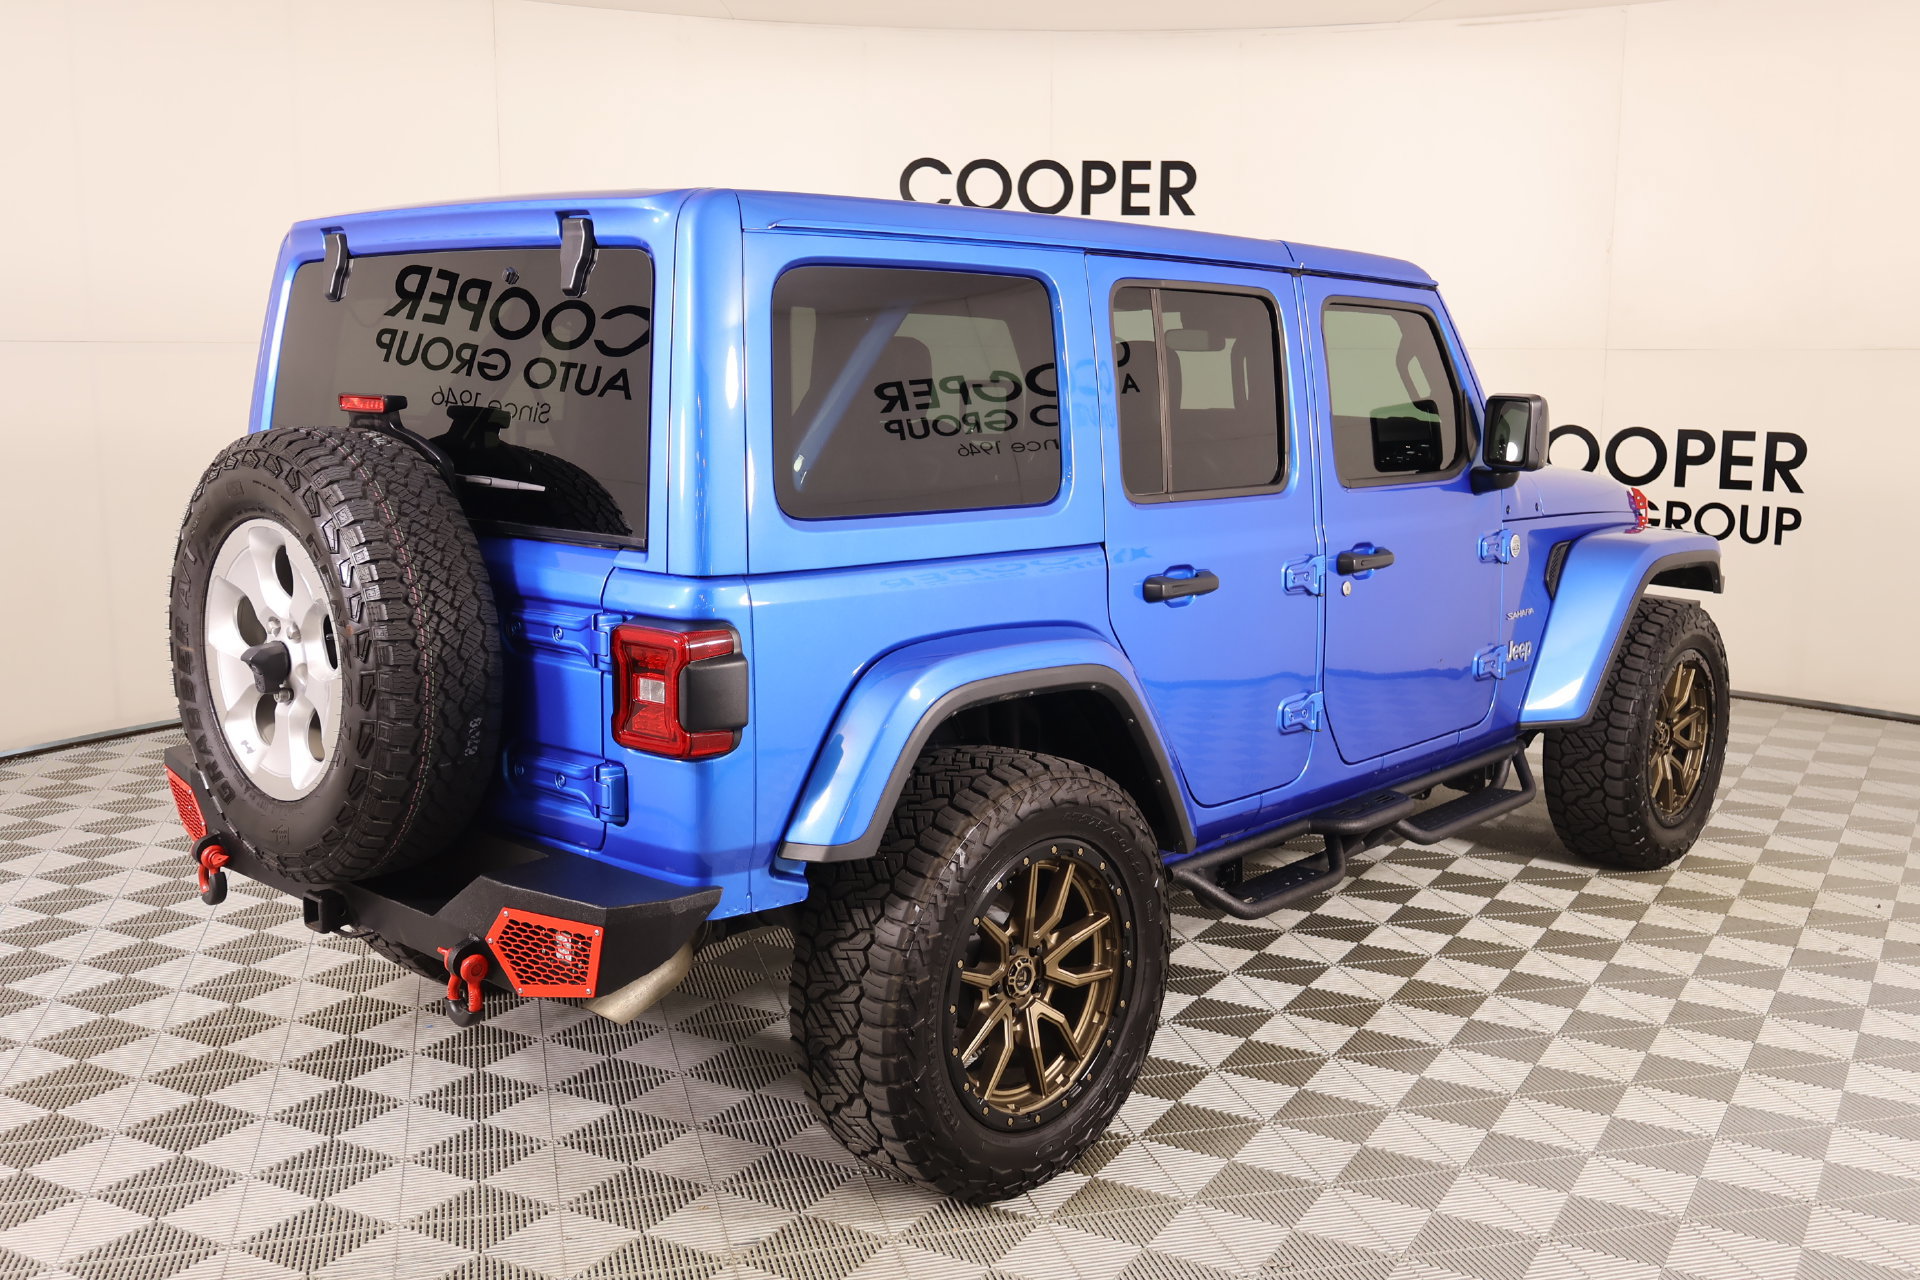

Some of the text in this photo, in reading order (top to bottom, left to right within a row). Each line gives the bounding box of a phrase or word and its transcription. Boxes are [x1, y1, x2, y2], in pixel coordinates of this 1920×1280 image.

[899, 157, 1197, 216] COOPER
[1547, 424, 1808, 494] OOPER
[1507, 640, 1532, 662] Jeep
[175, 615, 237, 804] GRABBER
